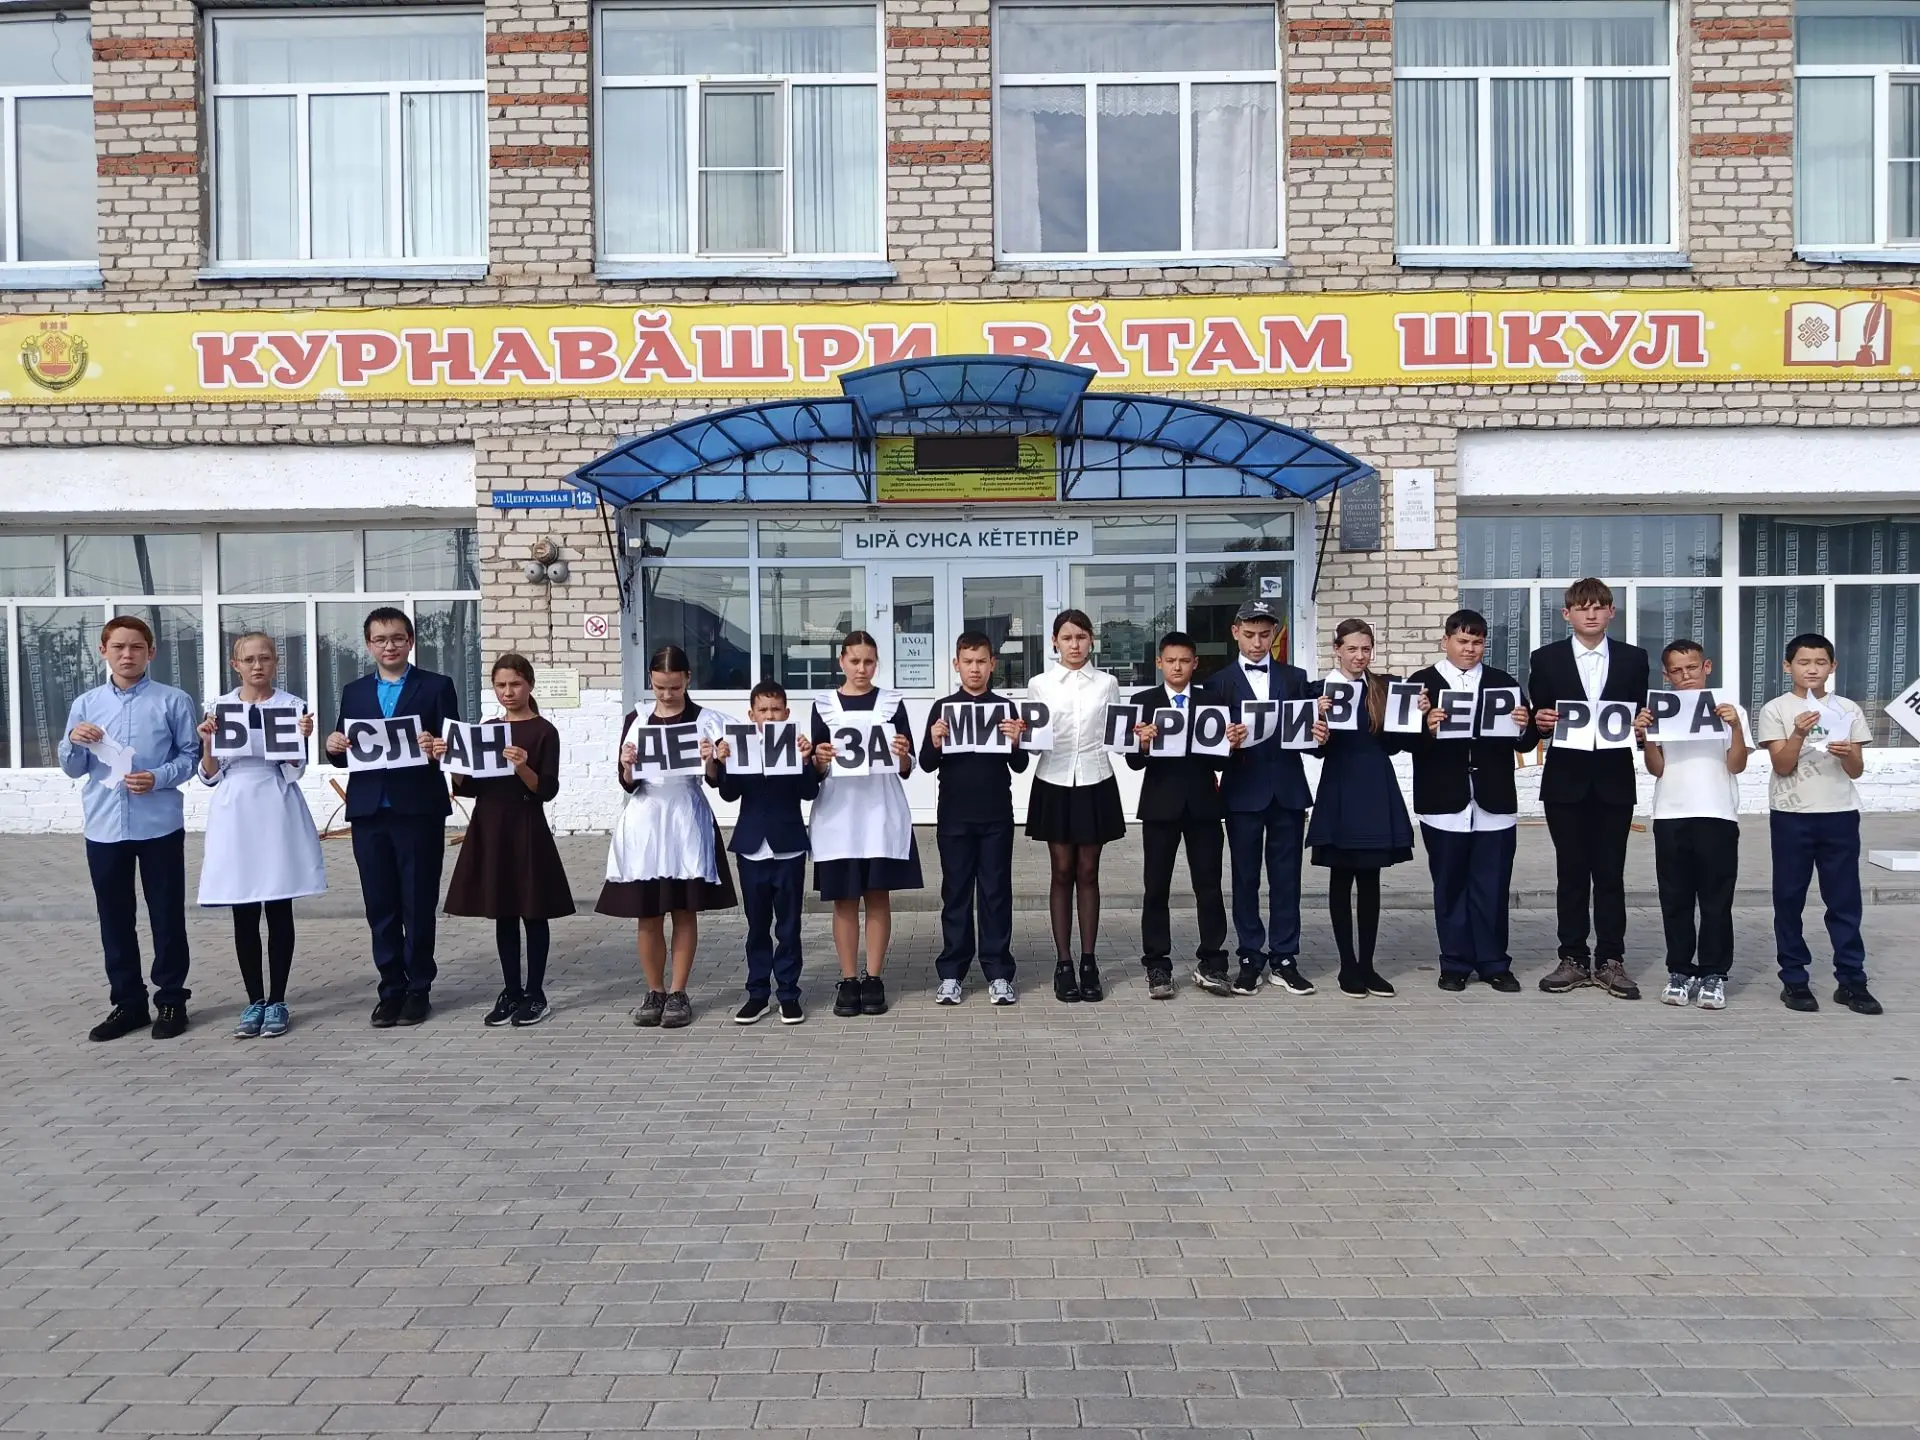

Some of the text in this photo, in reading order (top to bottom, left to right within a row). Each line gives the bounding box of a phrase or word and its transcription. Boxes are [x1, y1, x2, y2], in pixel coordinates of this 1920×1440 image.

[985, 308, 1349, 373] ВӐТАМ
[1399, 313, 1708, 367] ШКУЛ
[576, 491, 592, 505] 125
[856, 529, 900, 548] ЫРӐ
[905, 532, 972, 548] СУНСА
[901, 636, 927, 645] ВХОД
[635, 722, 798, 772] ДЕТИ
[834, 723, 894, 769] ЗА
[942, 701, 1051, 747] МИР
[1103, 682, 1354, 750] ПРОТИВ
[1391, 684, 1726, 743] ТЕРРОРА
